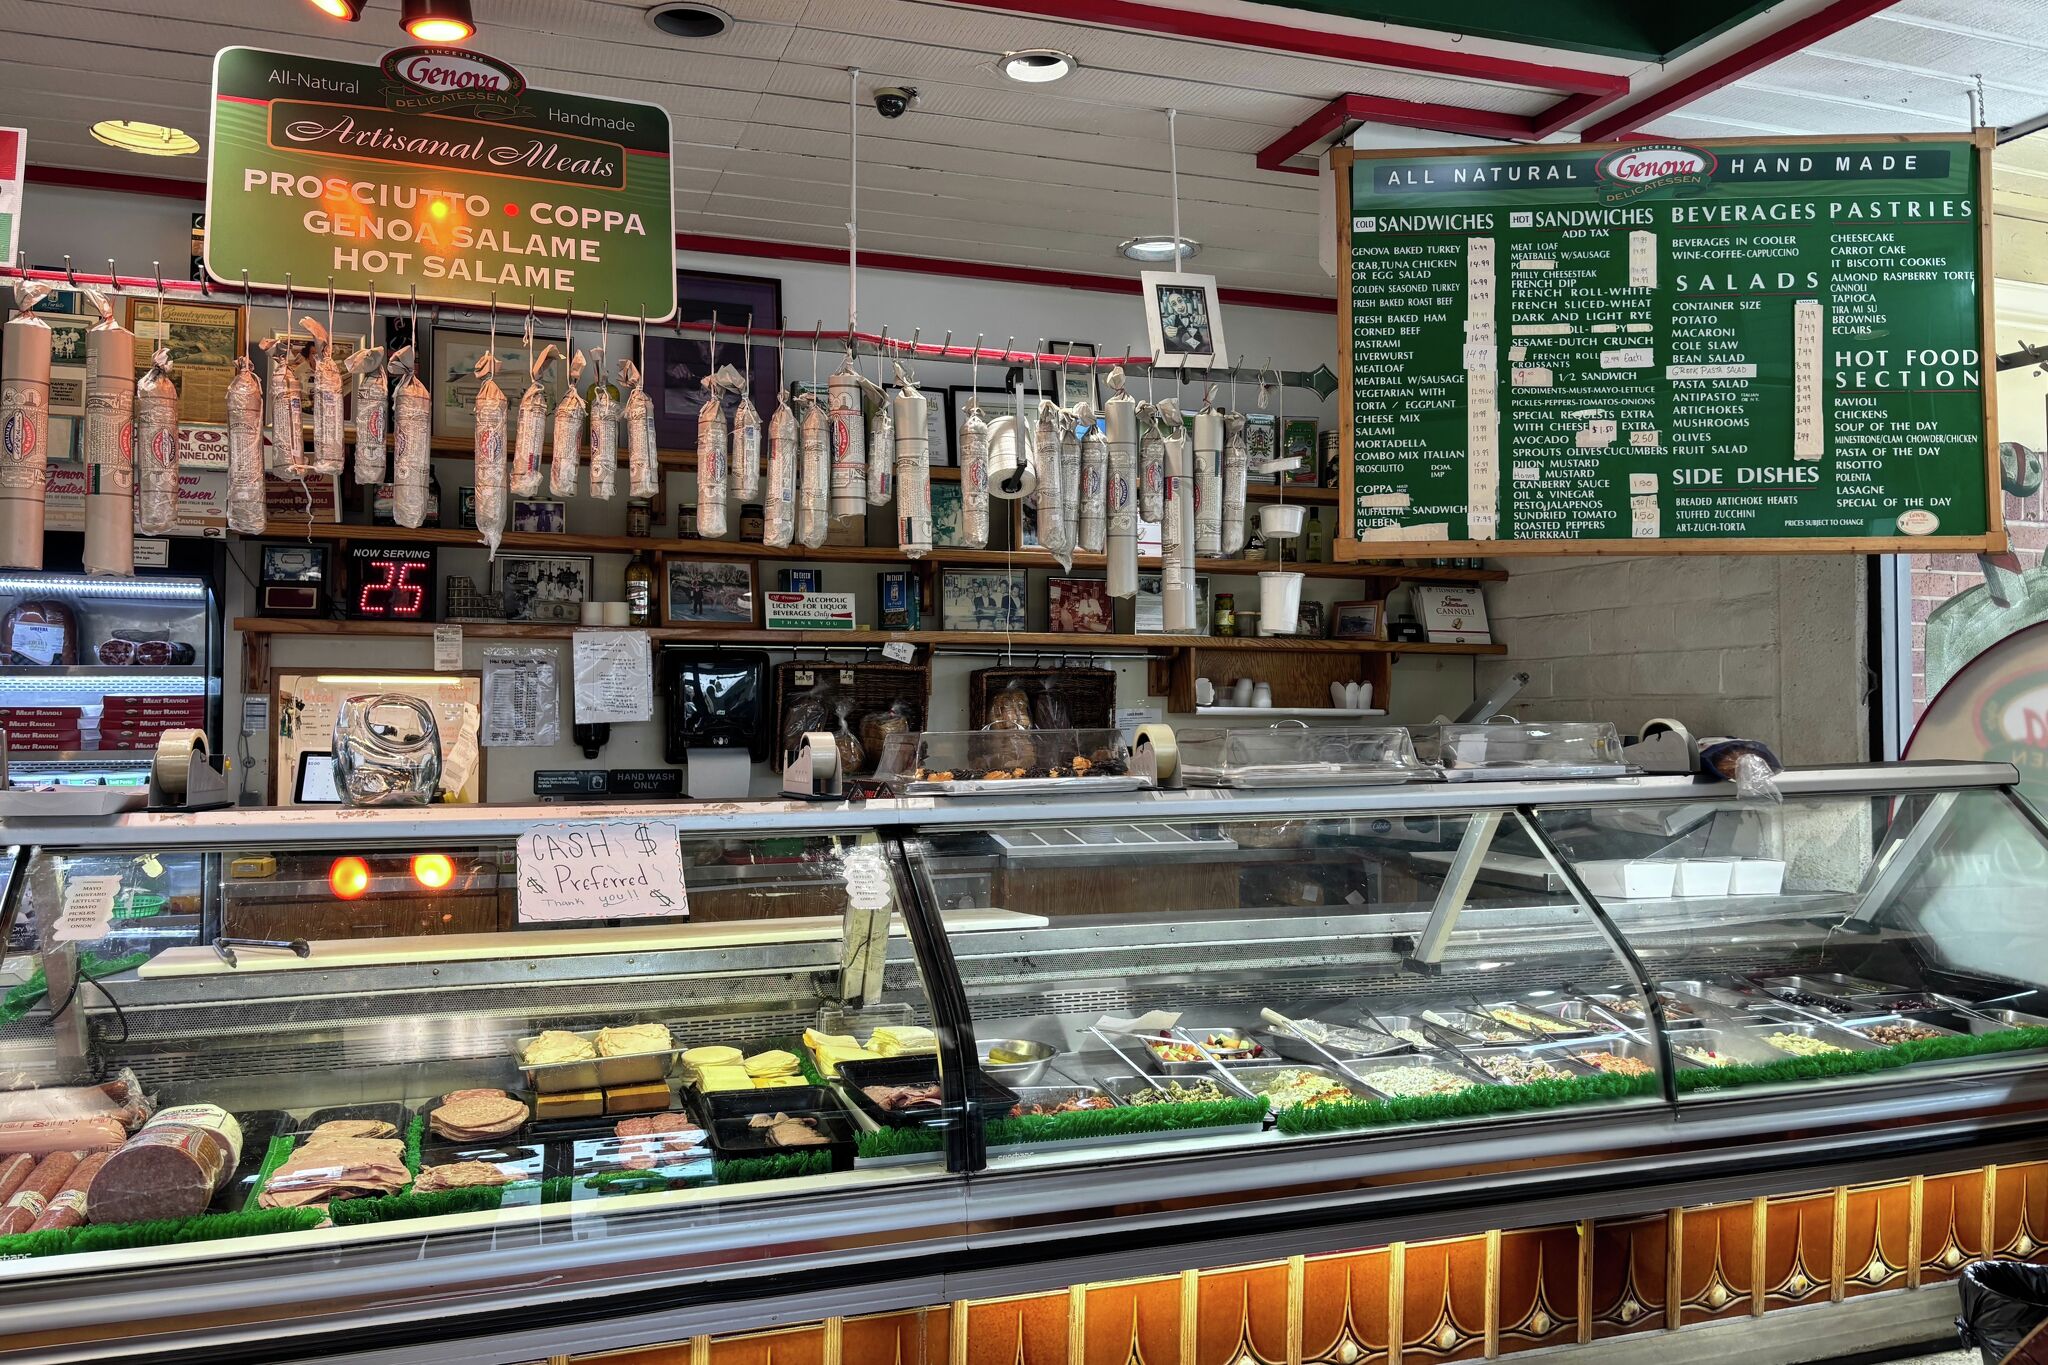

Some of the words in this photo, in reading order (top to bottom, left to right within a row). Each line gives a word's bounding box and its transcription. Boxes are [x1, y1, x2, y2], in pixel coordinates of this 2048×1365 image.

[407, 57, 500, 91] Genova
[268, 69, 360, 94] All-Natural
[396, 91, 507, 108] DELICATESSEN
[548, 106, 636, 132] Handmade
[285, 114, 485, 161] Artisanal
[487, 139, 615, 178] Meats
[1616, 155, 1696, 181] Genova
[1731, 157, 1814, 175] HAND
[1835, 155, 1918, 172] MADE
[1388, 169, 1435, 186] ALL
[1454, 162, 1577, 183] NATURAL
[1606, 176, 1702, 202] DELICATESSEN
[243, 168, 491, 216] PROSCIUTTO
[529, 201, 645, 236] COPPA
[1672, 203, 1816, 222] BEVERAGES
[1830, 200, 1971, 218] PASTRIES
[1355, 220, 1374, 229] COLD
[1379, 213, 1494, 232] SANDWICHES
[1512, 215, 1530, 224] HOT
[1536, 208, 1653, 227] SANDWICHES
[302, 211, 438, 245] GENOA
[450, 221, 601, 262] SALAME
[1562, 230, 1587, 238] ADD
[1590, 228, 1610, 237] TAX
[1831, 233, 1894, 242] CHEESECAKE
[1672, 238, 1730, 247] BEVERAGES
[1735, 237, 1748, 246] IN
[1753, 236, 1796, 245] COOLER
[1351, 247, 1390, 256] GENOVA
[1394, 246, 1423, 255] BAKED
[1427, 246, 1460, 254] TURKEY
[334, 246, 412, 276] HOT
[422, 255, 575, 292] SALAME
[1511, 271, 1539, 279] PHILLY
[1543, 269, 1597, 278] CHEESESTEAK
[1512, 280, 1552, 288] FRENCH
[1559, 279, 1576, 287] DIP
[1676, 272, 1818, 291] SALADS
[1352, 285, 1385, 294] GOLDEN
[1389, 284, 1427, 293] SEASONED
[1432, 283, 1460, 292] TURKEY
[1831, 294, 1876, 303] TAPIOCA
[1672, 302, 1734, 311] CONTAINER
[1739, 301, 1761, 310] SIZE
[1512, 313, 1545, 322] DARK
[1551, 312, 1579, 321] AND
[1586, 312, 1622, 320] LIGHT
[1630, 311, 1652, 320] RYE
[1672, 316, 1717, 324] POTATO
[1832, 315, 1886, 323] BROWNIES
[1354, 328, 1395, 336] CORNED
[1400, 326, 1421, 335] BEEF
[1672, 329, 1735, 337] MACARONI
[1832, 326, 1872, 334] ECLAIRS
[1355, 340, 1401, 348] PASTRAMI
[1355, 352, 1414, 361] LIVERWURST
[1835, 351, 1888, 367] HOT
[1907, 350, 1978, 366] FOOD
[1355, 364, 1404, 373] MEATLOAF
[1836, 370, 1979, 388] SECTION
[1355, 389, 1414, 398] VEGETARIAN
[1419, 388, 1445, 396] WITH
[1673, 393, 1736, 402] ANTIPASTO
[1835, 398, 1877, 406] RAVIOLI
[1673, 406, 1744, 414] ARTICHOKES
[1834, 410, 1888, 419] CHICKENS
[1673, 418, 1749, 427] MUSHROOMS
[1355, 427, 1394, 436] SALAMI
[1355, 439, 1426, 448] MORTADELLA
[1513, 436, 1569, 444] AVOCADO
[1355, 452, 1394, 461] COMBO
[1399, 451, 1419, 459] MIX
[1424, 450, 1464, 459] ITALIAN
[1513, 448, 1561, 456] SPROUTS
[1566, 447, 1602, 456] OLIVES
[1604, 447, 1668, 455] CUCUMBERS
[1836, 461, 1882, 469] RISOTTO
[1545, 469, 1595, 478] MUSTARD
[1673, 468, 1723, 484] SIDE
[1737, 467, 1820, 483] DISHES
[1835, 473, 1871, 482] POLENTA
[1512, 480, 1572, 489] CRANBERRY
[1577, 479, 1610, 488] SAUCE
[1356, 485, 1392, 494] COPPA
[1837, 486, 1884, 494] LASAGNE
[1676, 497, 1712, 506] BREADED
[1716, 497, 1763, 505] ARTICHOKE
[1767, 496, 1798, 504] HEARTS
[1514, 511, 1566, 520] SUNDRIED
[1573, 510, 1617, 519] TOMATO
[1676, 510, 1709, 519] STUFFED
[1714, 509, 1755, 518] ZUCCHINI
[1514, 521, 1561, 530] ROASTED
[1566, 521, 1606, 529] PEPPERS
[1514, 531, 1580, 539] SAUERKRAUT
[353, 548, 381, 557] NOW
[383, 550, 430, 558] SERVING
[360, 562, 425, 611] 25
[814, 611, 830, 620] Only
[617, 773, 645, 781] HAND
[647, 773, 675, 781] WASH
[633, 781, 658, 790] ONLY
[532, 830, 610, 860] CASH
[554, 864, 648, 893] Preferred
